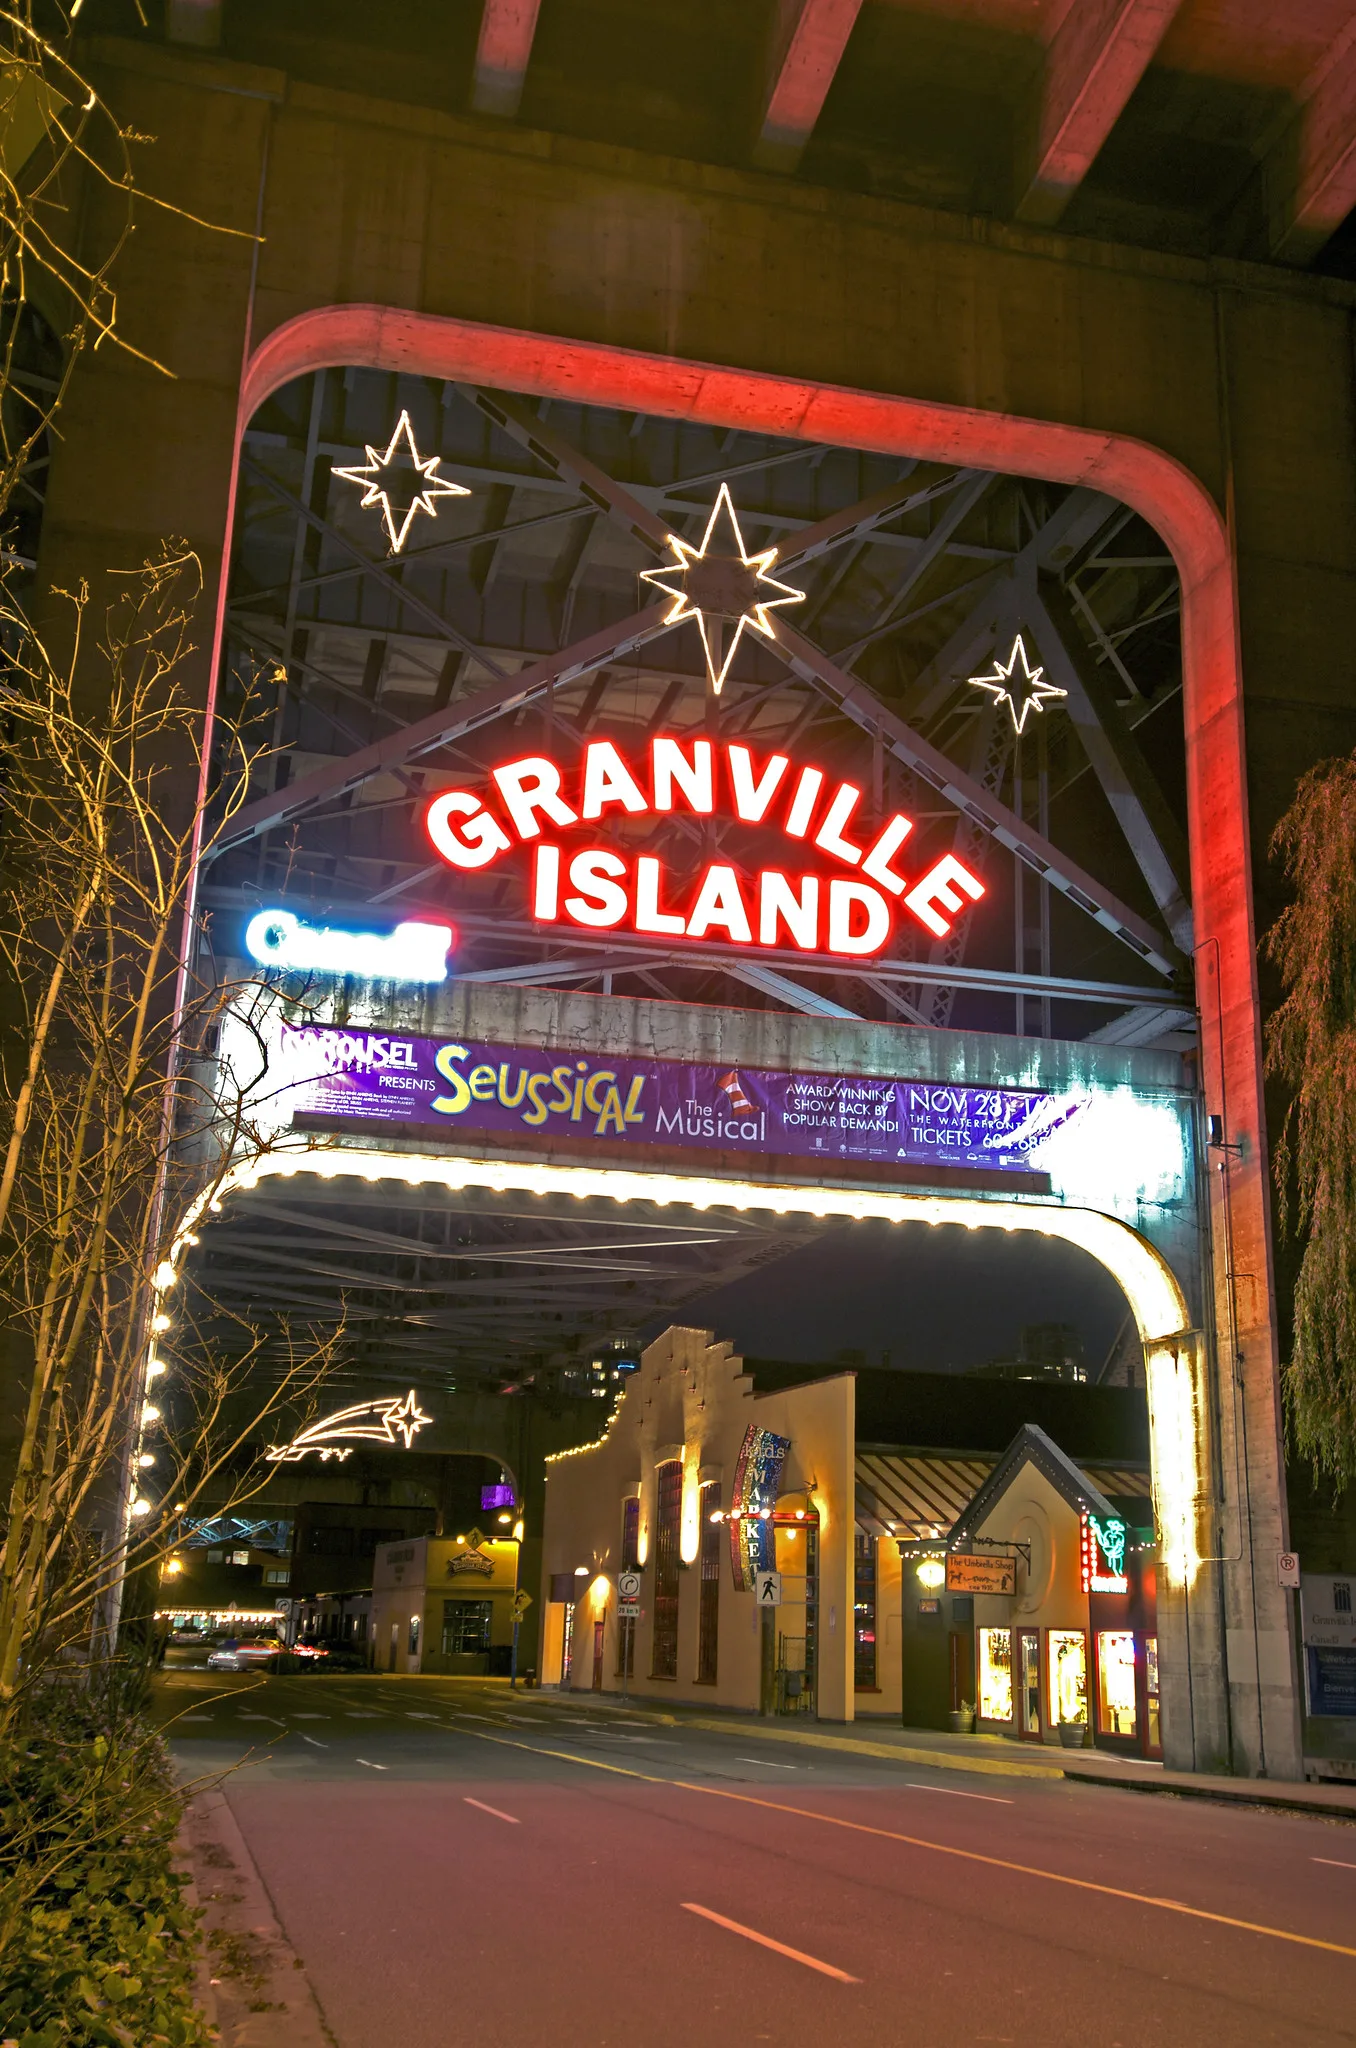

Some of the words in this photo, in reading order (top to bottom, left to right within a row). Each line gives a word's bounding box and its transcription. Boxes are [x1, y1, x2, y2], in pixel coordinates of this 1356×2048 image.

[426, 737, 986, 938] GRANVILLE
[534, 845, 890, 955] ISLAND
[378, 1075, 436, 1091] PRESENTS
[786, 1083, 897, 1102] AWARD-WINNING
[685, 1099, 713, 1117] The
[793, 1098, 835, 1112] SHOW
[838, 1101, 871, 1115] BACK
[874, 1104, 889, 1117] BY
[910, 1088, 967, 1114] NOV
[655, 1105, 765, 1141] Musical
[783, 1112, 837, 1128] POPULAR
[840, 1117, 899, 1133] DEMAND!
[910, 1114, 931, 1125] THE
[938, 1116, 1022, 1130] WATERFRONT
[911, 1127, 972, 1147] TICKETS
[743, 1442, 786, 1459] kids
[950, 1556, 962, 1567] The
[964, 1557, 994, 1568] Umbrella
[995, 1560, 1013, 1571] Shop
